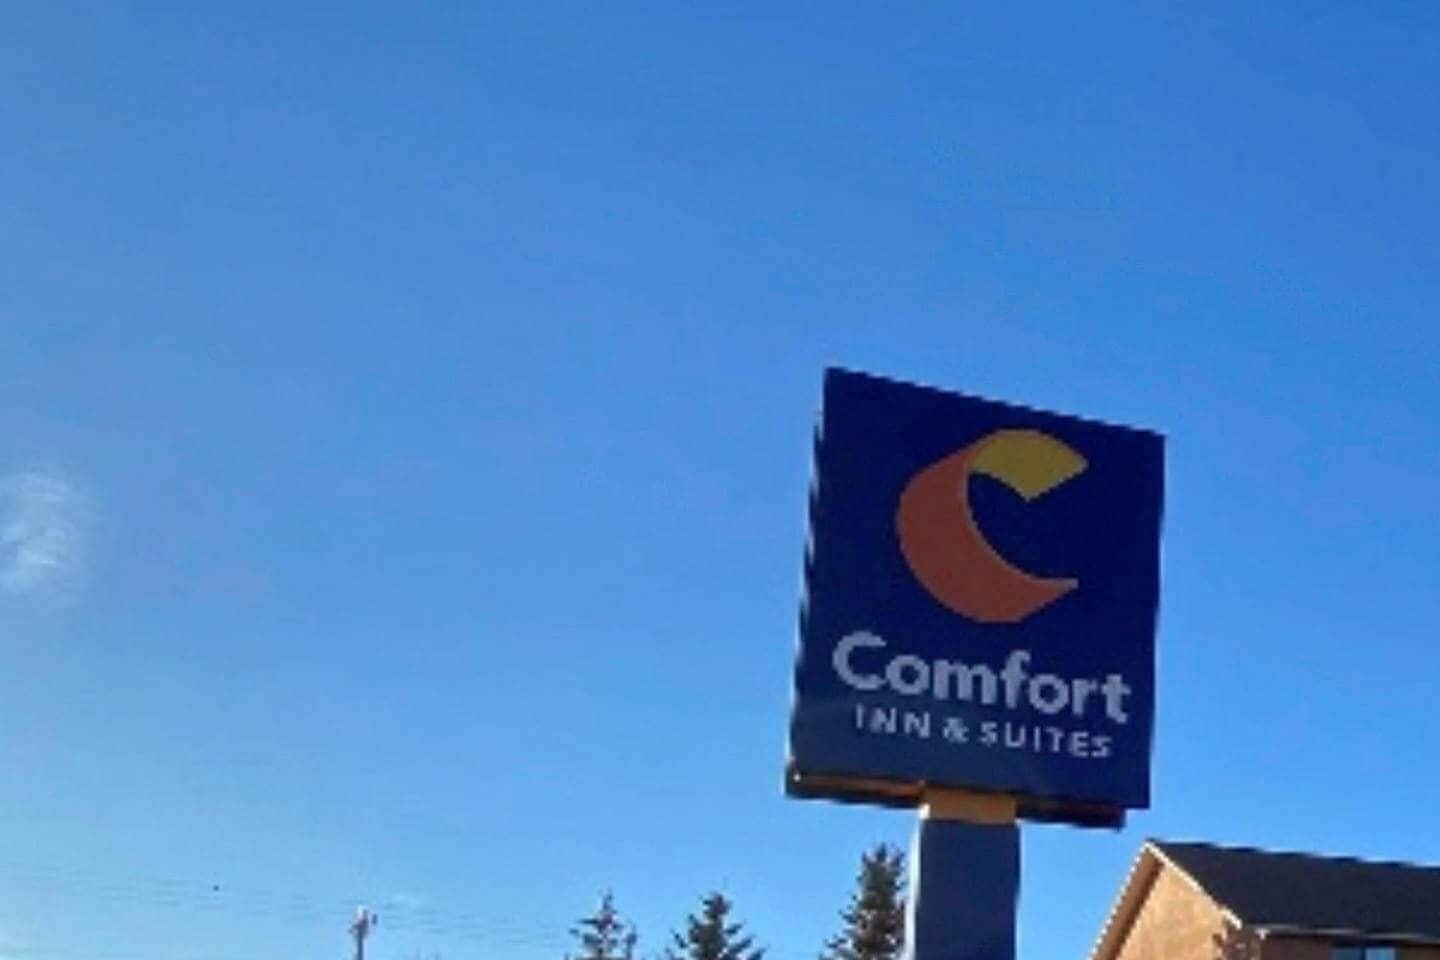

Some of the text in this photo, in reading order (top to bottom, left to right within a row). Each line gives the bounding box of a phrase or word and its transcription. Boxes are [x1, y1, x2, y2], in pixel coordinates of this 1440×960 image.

[832, 630, 1131, 723] Comfort
[855, 703, 1113, 758] INN & SUITES
